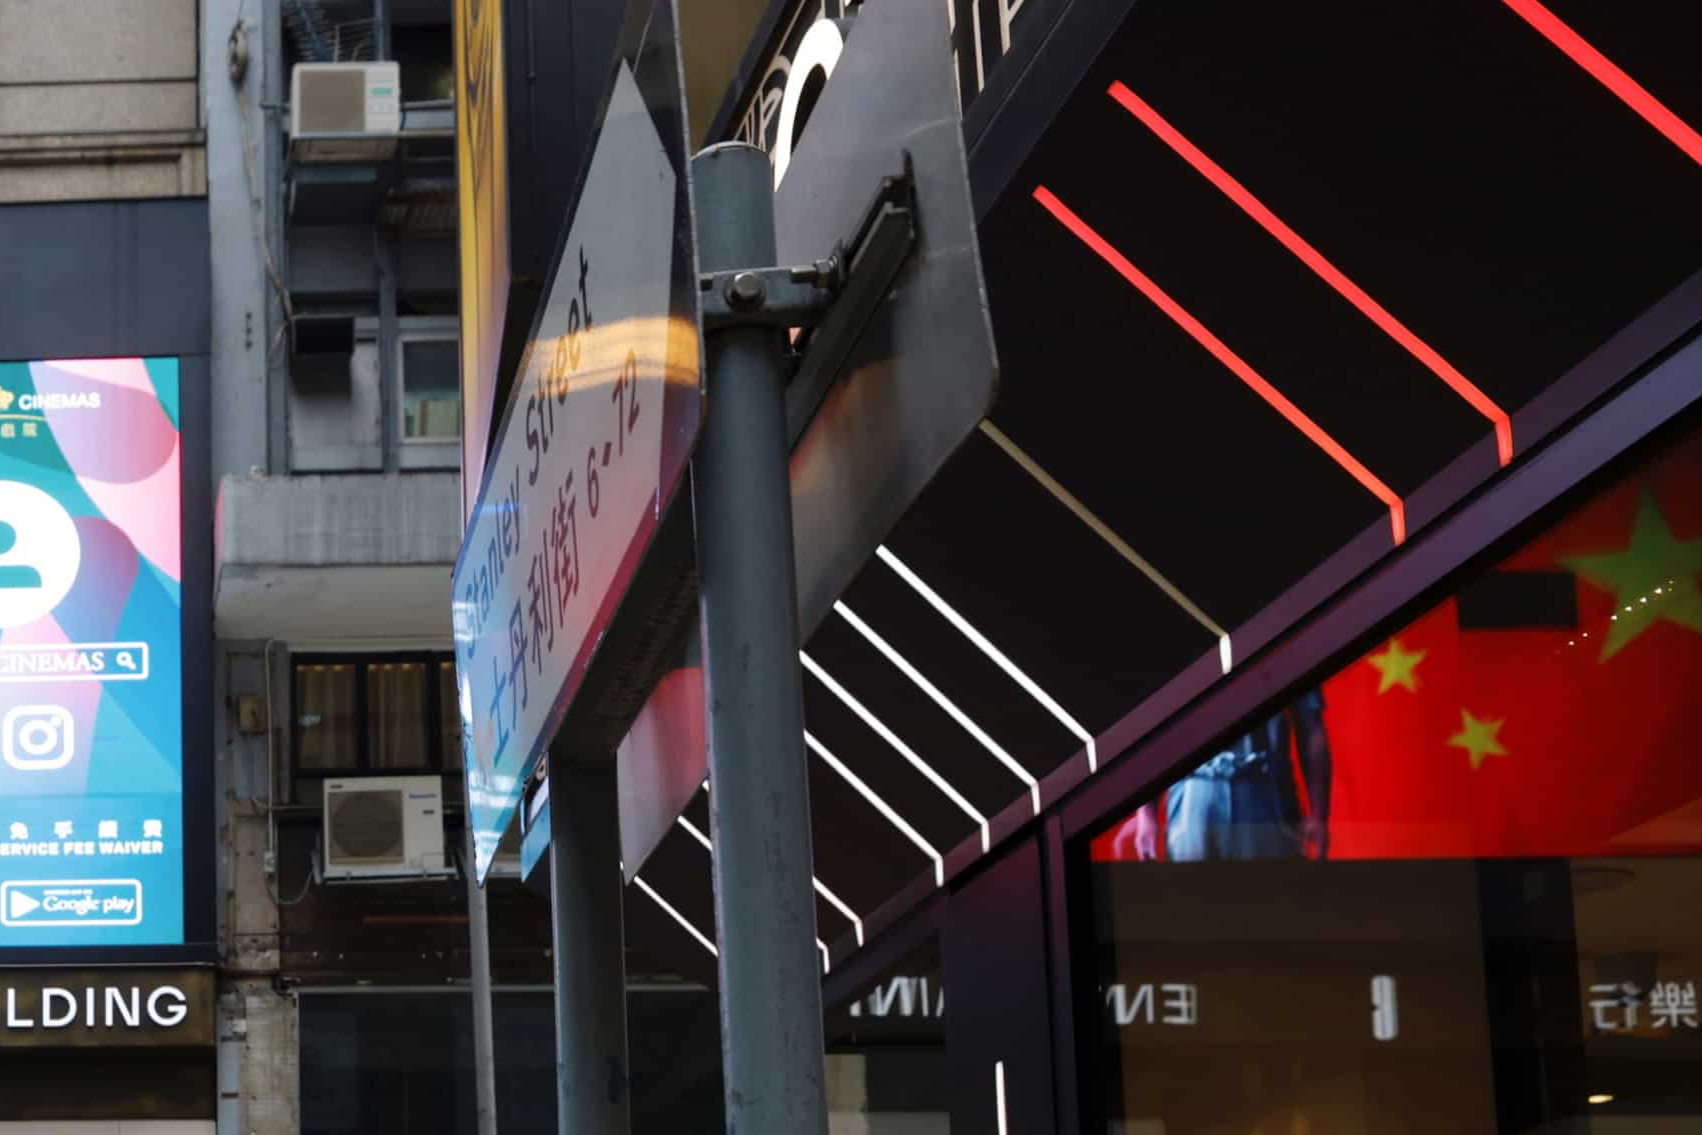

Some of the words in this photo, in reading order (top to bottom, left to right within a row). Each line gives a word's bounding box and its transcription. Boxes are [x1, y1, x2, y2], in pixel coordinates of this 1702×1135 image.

[18, 392, 102, 410] CINEMAS
[465, 464, 521, 660] Stanley
[526, 245, 593, 487] Street
[490, 468, 580, 769] 士丹利街
[63, 842, 95, 855] FEE
[99, 840, 163, 854] WAIVER
[42, 895, 100, 916] Google
